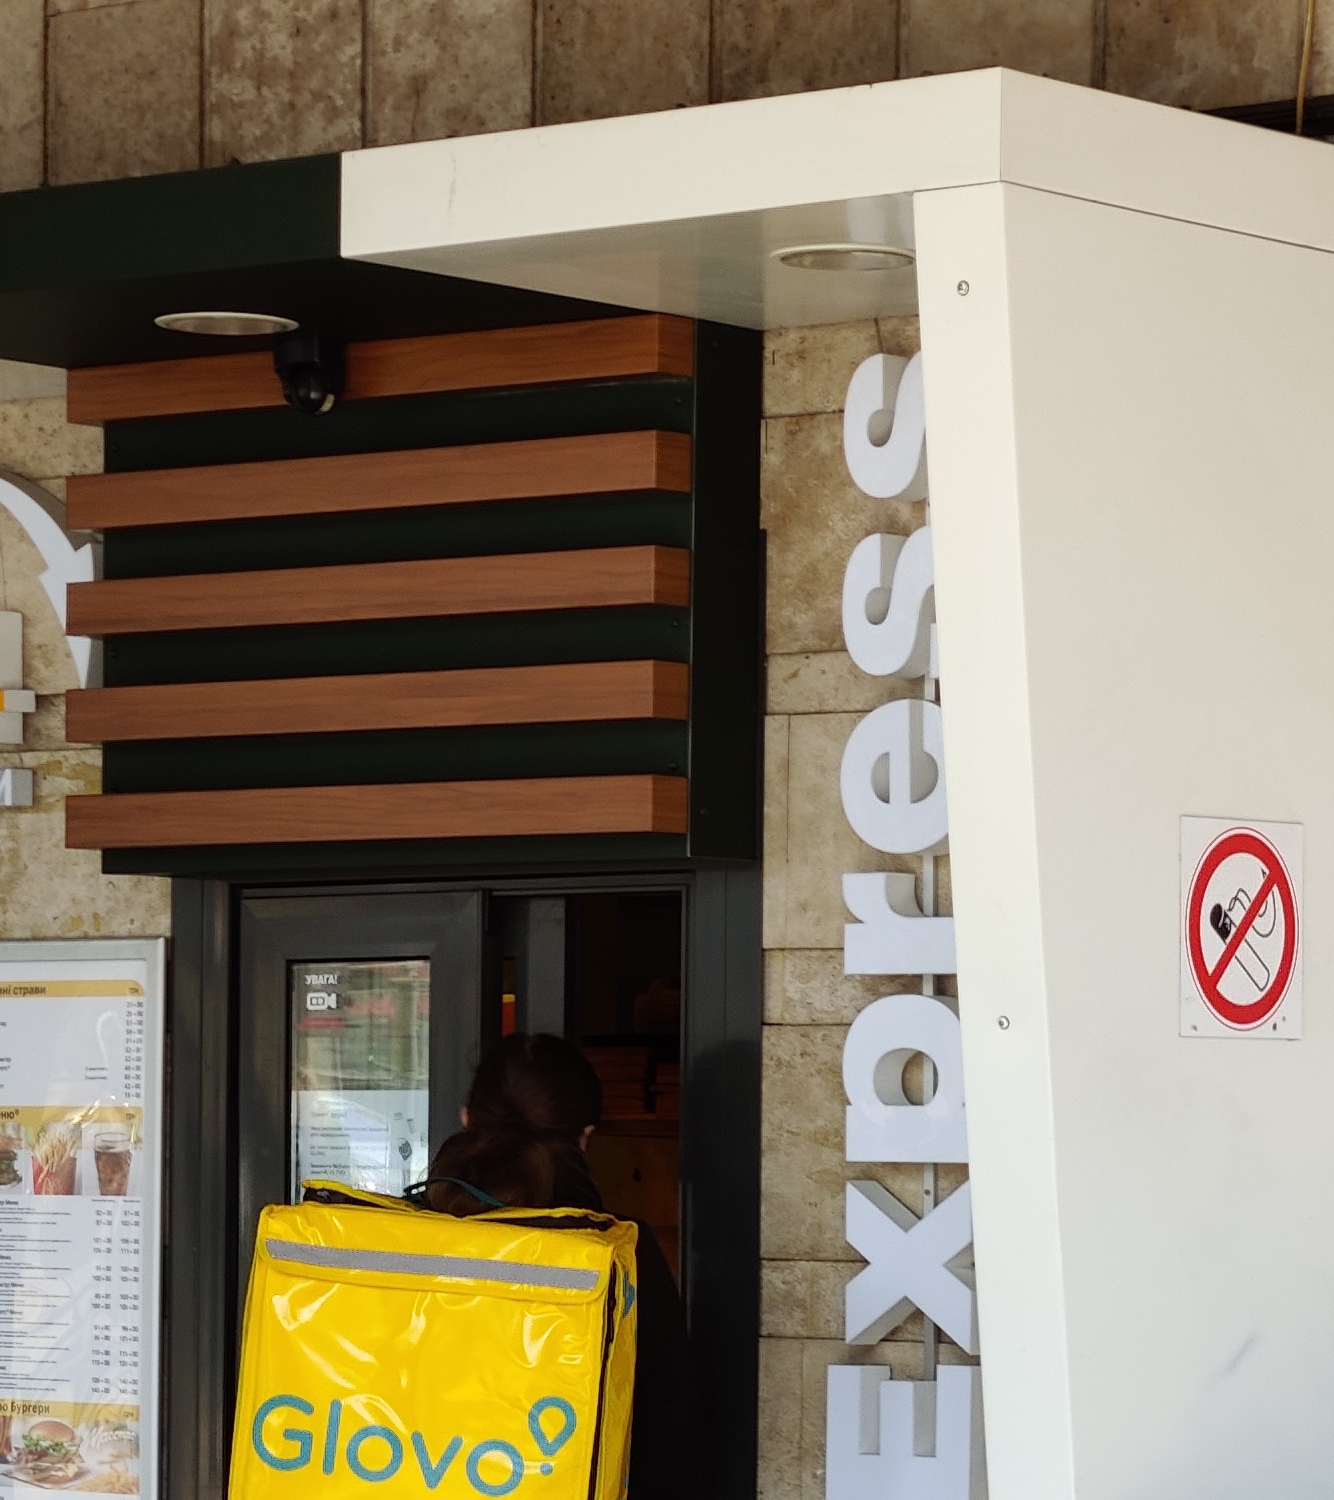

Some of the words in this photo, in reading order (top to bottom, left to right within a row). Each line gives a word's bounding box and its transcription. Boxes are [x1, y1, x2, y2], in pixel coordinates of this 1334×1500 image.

[304, 973, 339, 986] УВАГА!
[13, 985, 46, 997] страви
[252, 1394, 525, 1497] Glovo
